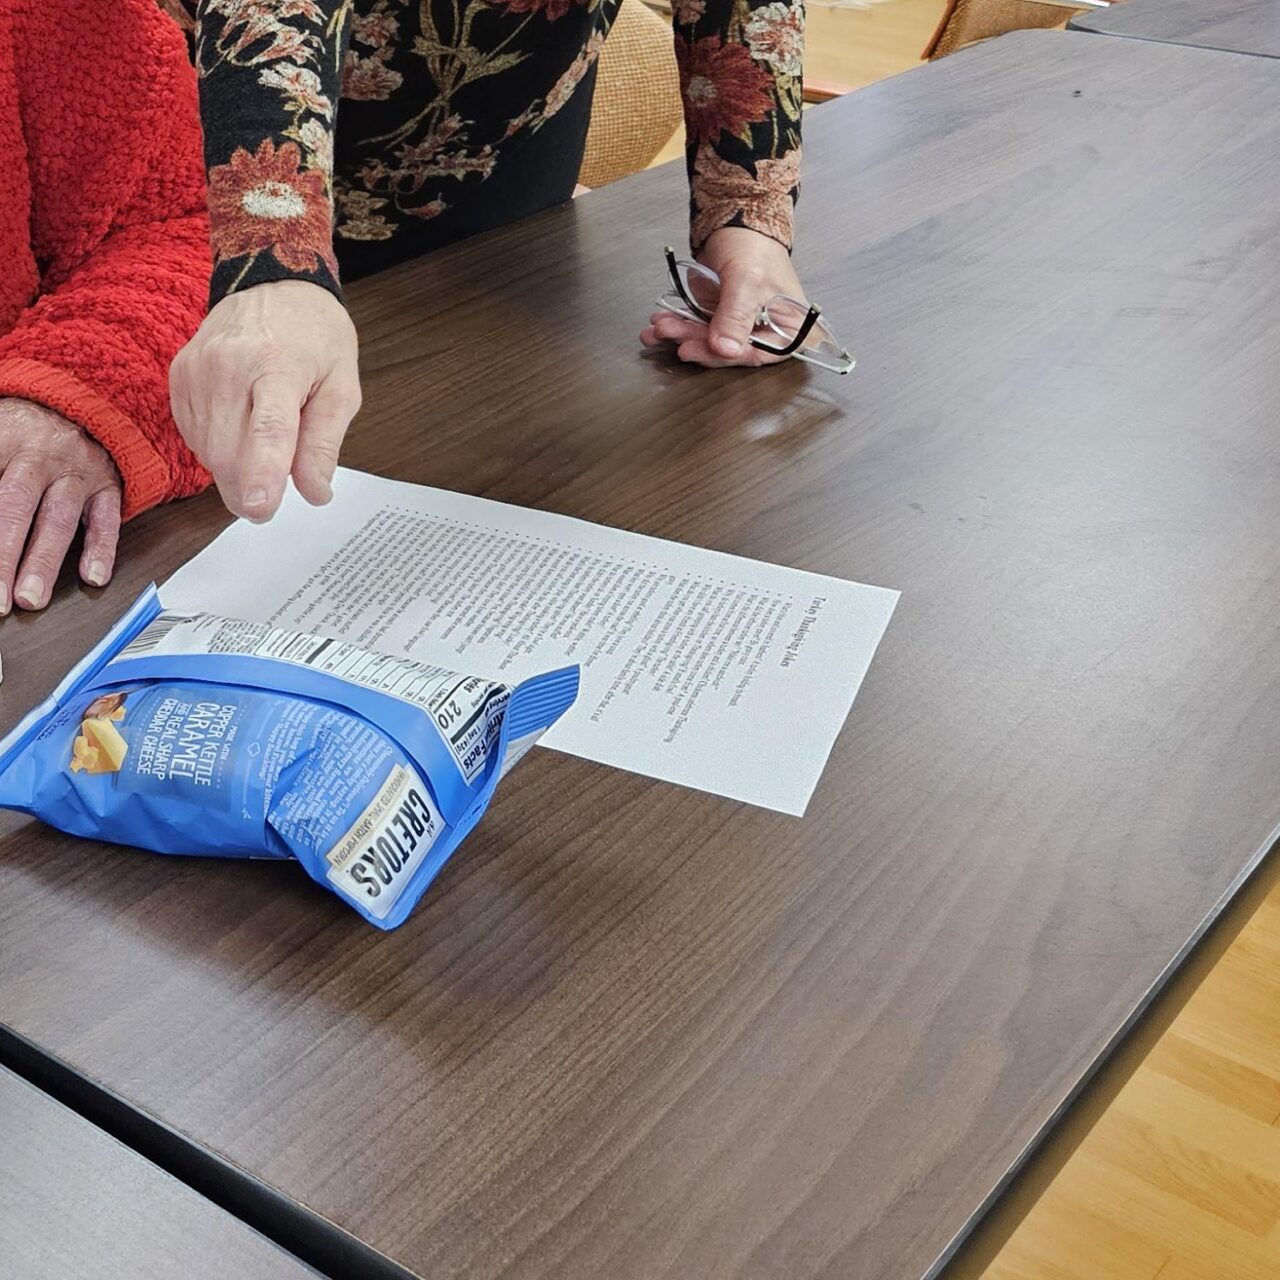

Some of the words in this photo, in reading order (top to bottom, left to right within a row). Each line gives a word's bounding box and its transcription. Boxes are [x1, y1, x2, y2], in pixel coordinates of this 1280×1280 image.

[147, 698, 177, 732] CHEDDAR
[160, 715, 183, 738] REAL
[207, 705, 236, 738] COPPER
[436, 700, 461, 729] 210
[169, 703, 219, 778] CARAMEL
[225, 725, 237, 741] MADE
[136, 735, 157, 774] CHEESE
[152, 741, 172, 780] SHARP
[194, 741, 219, 785] KETTLE
[220, 743, 230, 760] WITH
[462, 741, 489, 769] Facts
[348, 788, 432, 898] CRETORS
